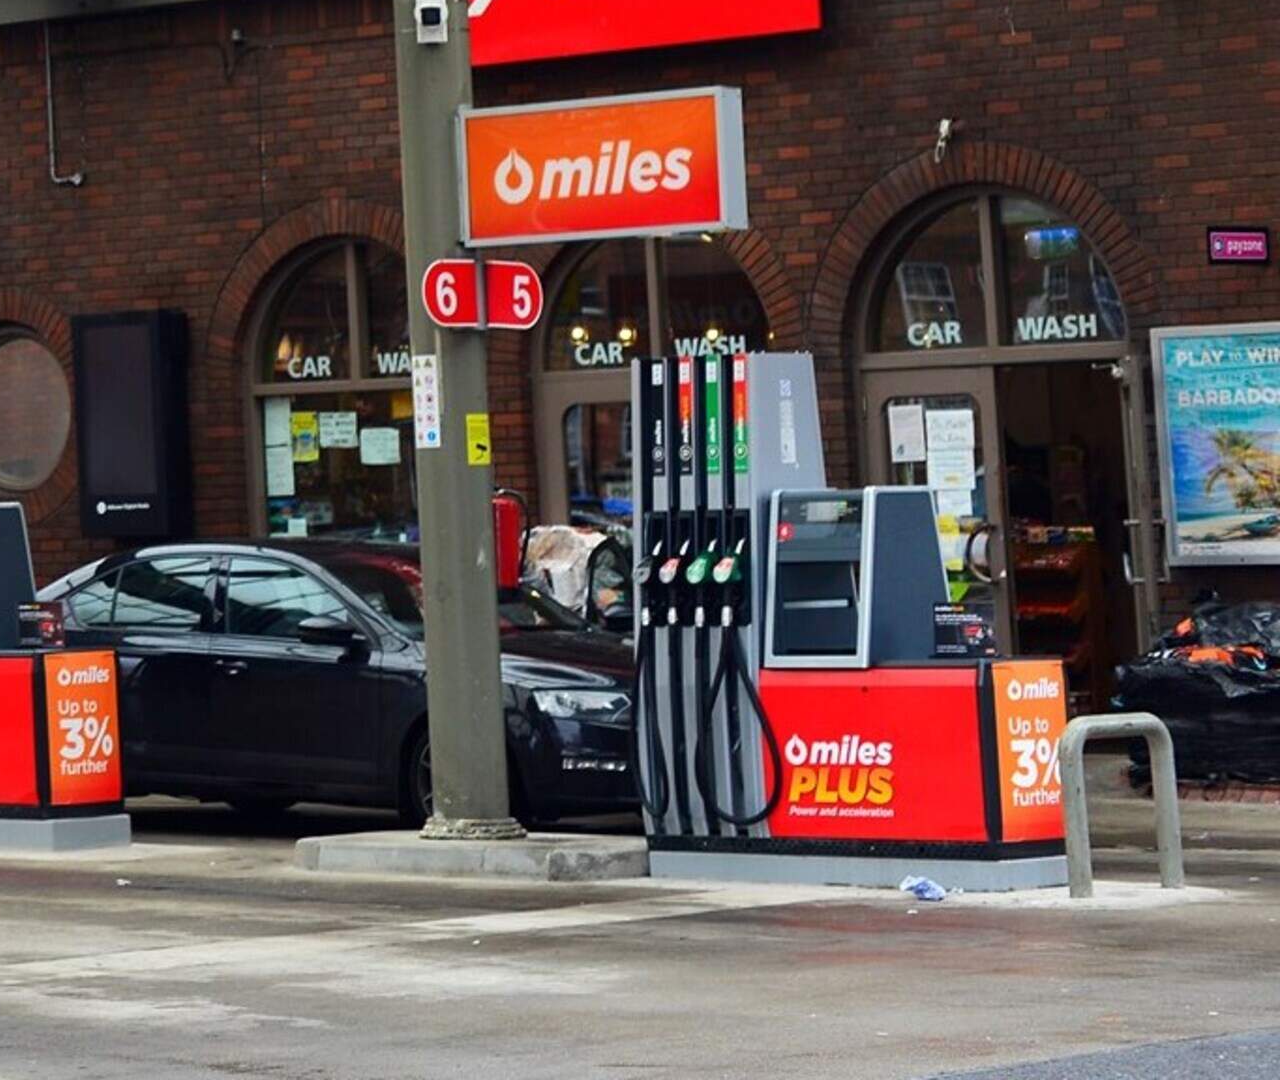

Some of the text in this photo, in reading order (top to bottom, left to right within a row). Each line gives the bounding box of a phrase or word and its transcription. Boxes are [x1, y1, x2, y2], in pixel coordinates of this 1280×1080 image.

[539, 138, 693, 202] miles
[1226, 238, 1264, 256] payzone
[436, 271, 458, 316] 6
[513, 275, 531, 320] 5
[907, 313, 1098, 347] CAR WASH
[574, 335, 746, 366] CAR WASH
[1175, 348, 1225, 368] PLAY
[287, 351, 412, 379] CAR WA
[1177, 386, 1280, 408] BARBADO
[71, 665, 109, 685] miles
[1024, 677, 1059, 700] miles
[57, 699, 97, 716] Up to
[59, 715, 113, 760] 3%
[1008, 716, 1049, 736] Up to
[810, 734, 893, 765] miles
[60, 758, 109, 776] further
[1010, 738, 1061, 787] 3%
[788, 766, 895, 805] PLUS
[1012, 786, 1060, 807] further
[789, 804, 895, 818] Power and acceleration
